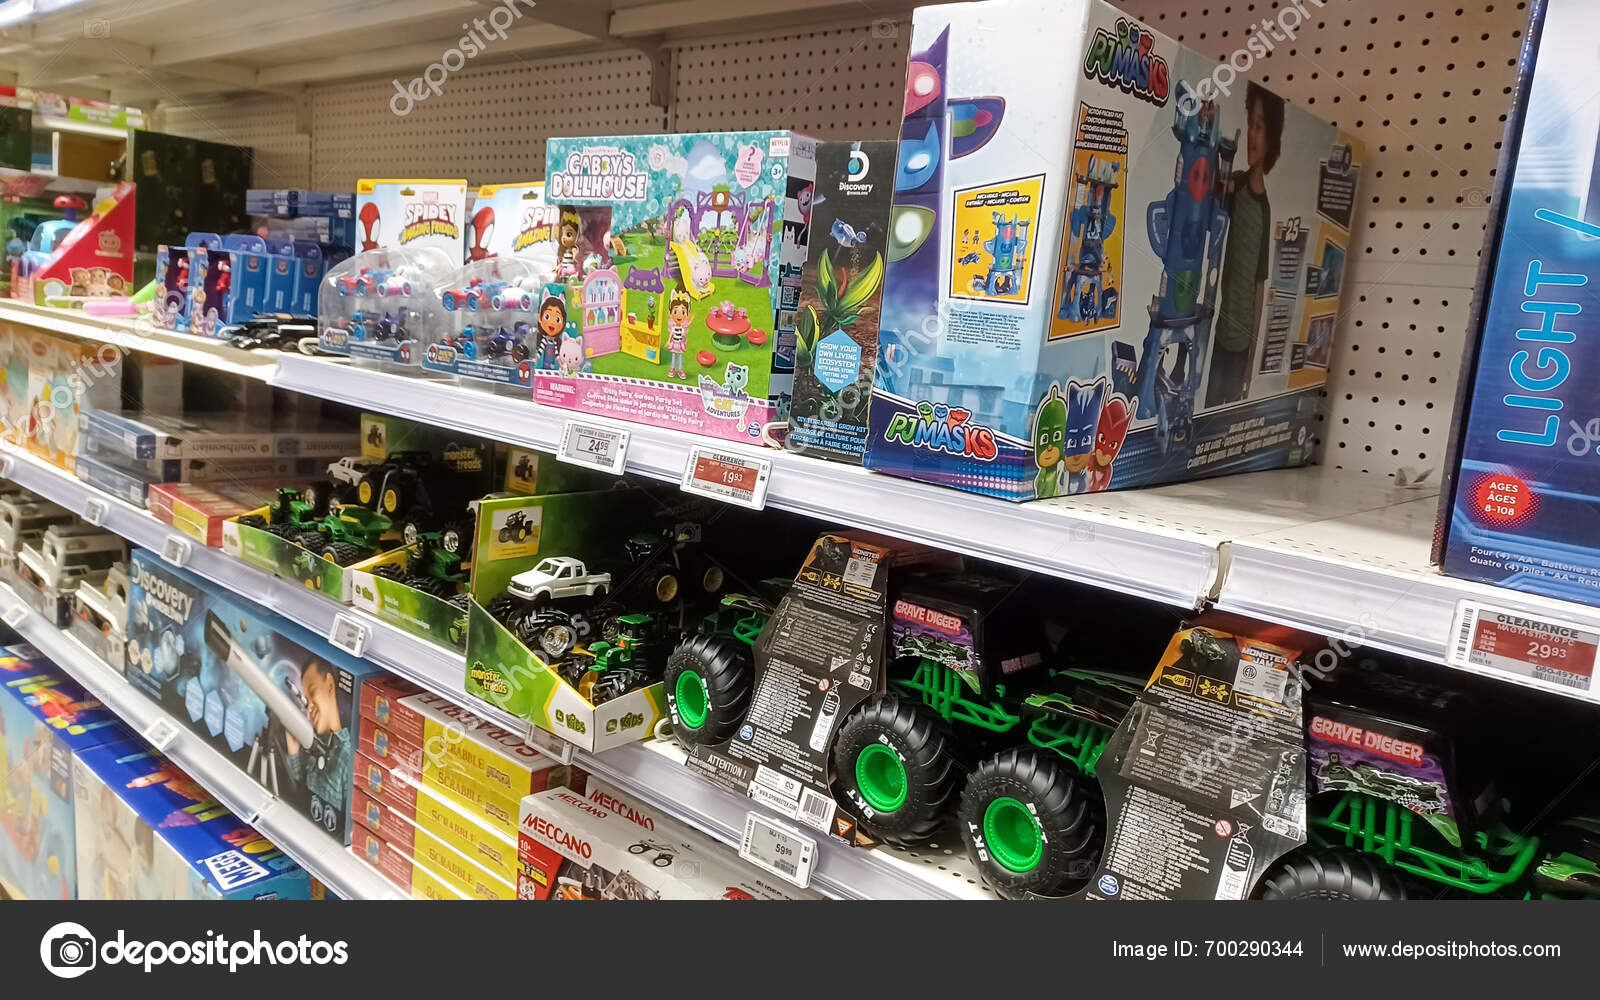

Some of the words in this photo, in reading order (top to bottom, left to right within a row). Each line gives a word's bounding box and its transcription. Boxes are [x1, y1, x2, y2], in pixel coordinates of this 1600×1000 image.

[568, 153, 634, 177] GABBY'S
[551, 174, 647, 199] DOLLHOUSE
[839, 182, 873, 193] Discovery
[405, 203, 456, 226] SPIDEY
[521, 206, 560, 231] SPI
[818, 358, 856, 369] ECOSYSTEM
[819, 350, 833, 358] OWN
[834, 352, 857, 360] LIVING
[1496, 260, 1588, 446] LIGHT
[672, 398, 683, 406] Set
[706, 405, 741, 418] ADVENTURES
[825, 431, 849, 441] CULTURE
[849, 436, 866, 445] POUR
[838, 422, 856, 431] GROW
[915, 417, 998, 460] MASKS
[192, 444, 257, 454] Smithsonian
[790, 433, 820, 445] TERRARIUM
[825, 439, 841, 449] FAIRE
[712, 453, 745, 467] CLEARANCE
[1487, 490, 1517, 504] ÂGES
[1489, 482, 1519, 493] AGES
[1484, 505, 1515, 516] 8-108
[1469, 556, 1502, 569] Quatre
[1504, 562, 1519, 572] (4)
[1522, 566, 1546, 577] Piles
[1471, 546, 1493, 557] Four
[1495, 551, 1511, 560] (4)
[1541, 560, 1588, 574] Batteries
[131, 559, 193, 621] Discovery
[895, 600, 926, 621] GRAVE
[926, 609, 962, 631] DIGGER
[1497, 614, 1579, 639] CLEARANCE
[1497, 623, 1547, 640] MAGTASTIC
[1562, 639, 1575, 647] PC
[1241, 647, 1289, 665] MONSTER
[1252, 657, 1274, 669] JAM
[471, 668, 501, 682] monster
[483, 680, 507, 695] treads
[667, 693, 679, 725] BKT
[878, 734, 907, 763] BKT
[1311, 716, 1363, 746] GRAVE
[1364, 731, 1424, 762] DIGGER
[707, 754, 744, 778] ATTENTION
[437, 771, 483, 804] SCRABBLE
[555, 792, 608, 820] MECCANO
[589, 789, 655, 832] MECCANO
[846, 789, 875, 820] BKT
[431, 808, 477, 844] SCRABBLE
[522, 812, 593, 860] MECCANO
[1025, 802, 1049, 846] BKT
[519, 839, 532, 851] 10+
[967, 820, 990, 862] BKT
[209, 851, 261, 885] MEGA
[428, 846, 474, 885] SCRABBLE
